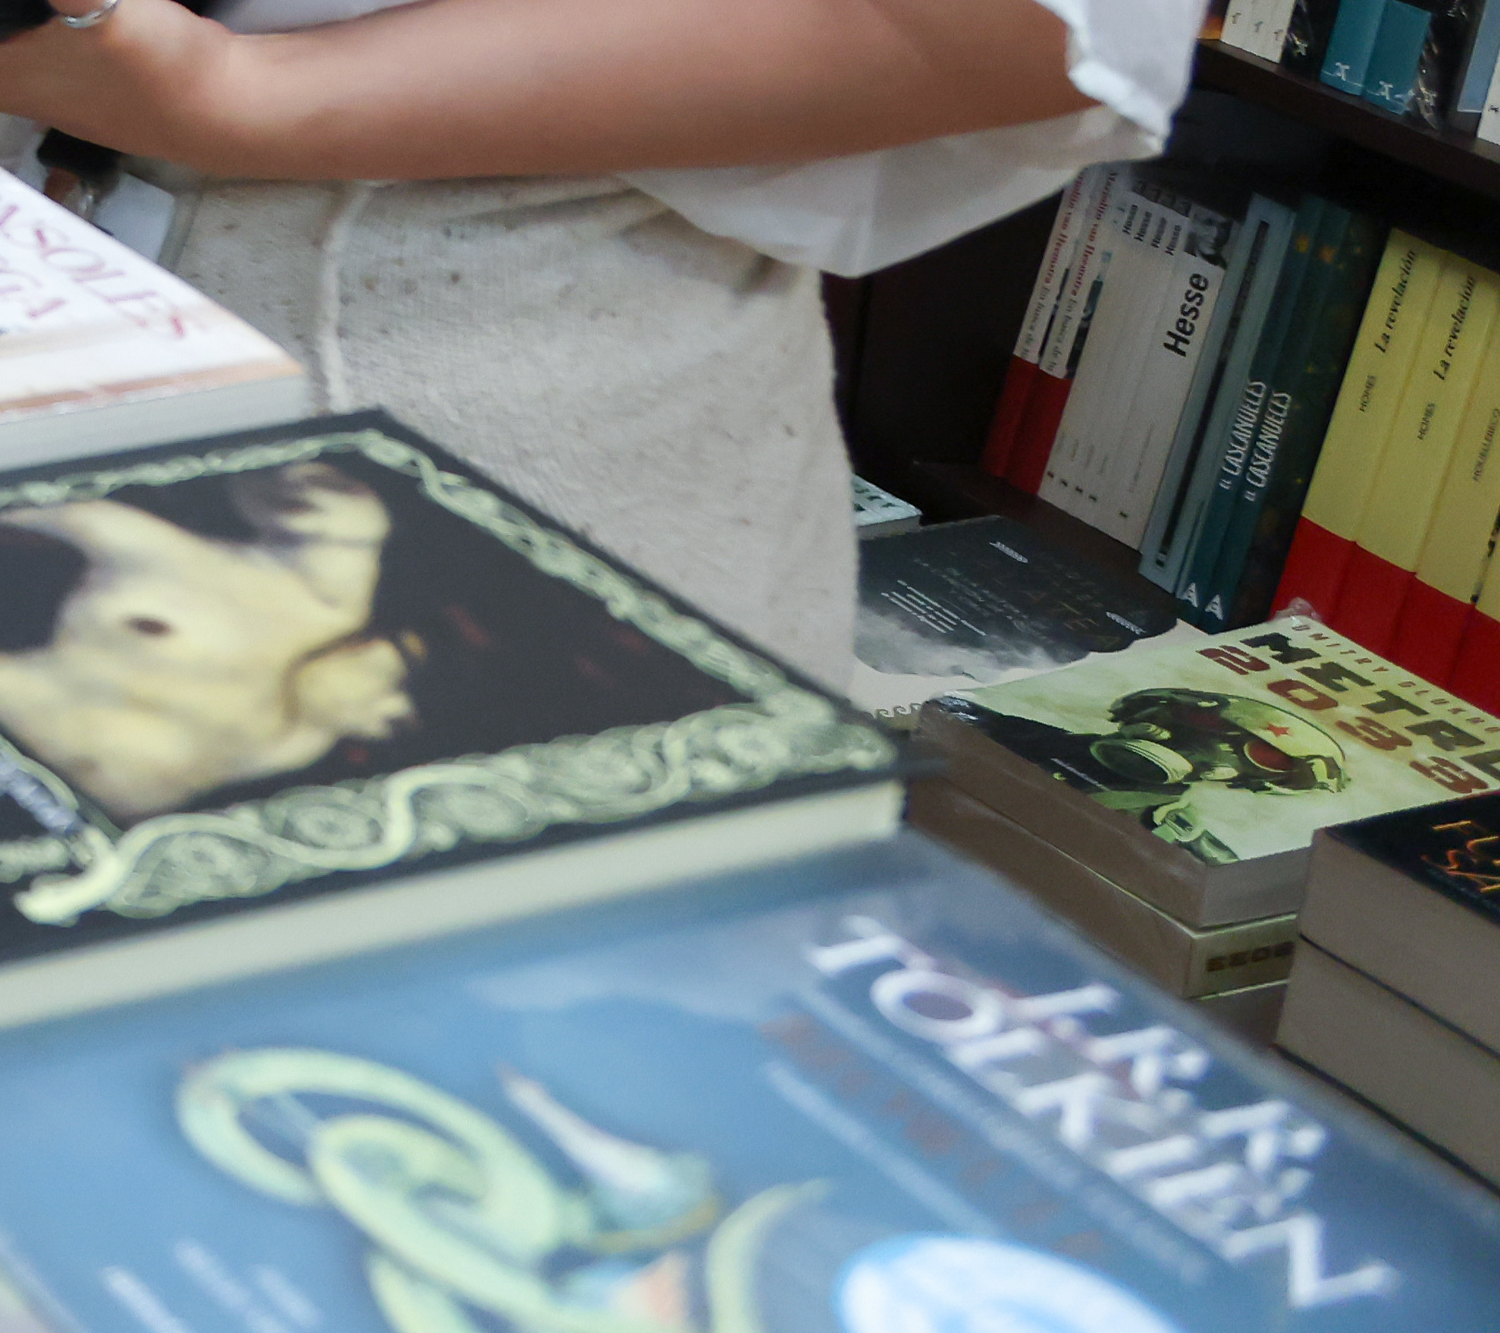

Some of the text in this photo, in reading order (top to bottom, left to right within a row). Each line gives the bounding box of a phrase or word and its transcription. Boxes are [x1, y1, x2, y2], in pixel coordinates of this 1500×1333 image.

[1163, 272, 1209, 357] Hesse
[1385, 249, 1417, 332] revelación
[1195, 645, 1489, 793] 2033
[803, 925, 1402, 1309] TOLKIEN
